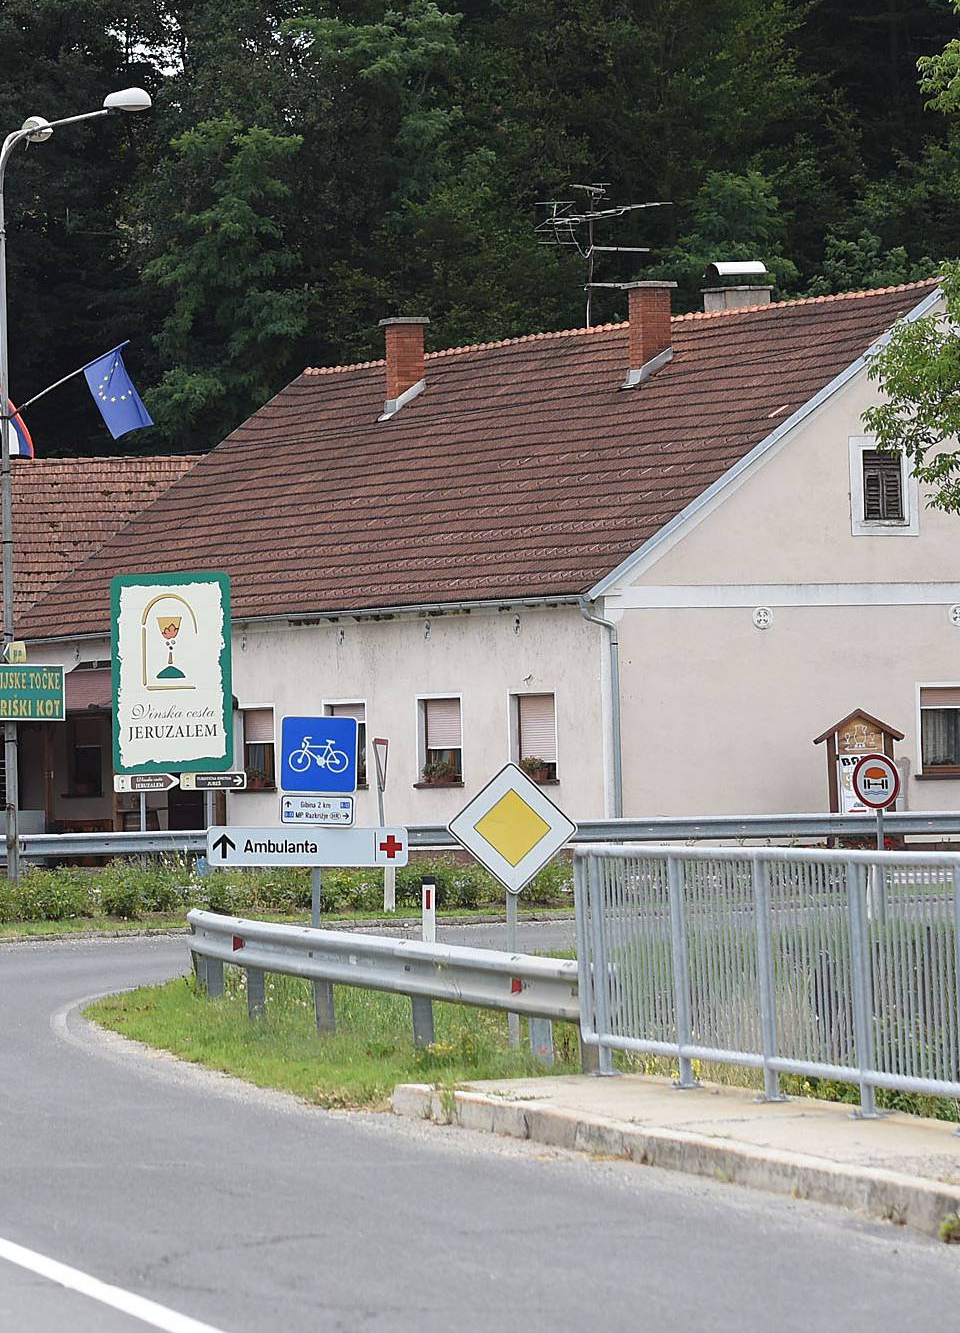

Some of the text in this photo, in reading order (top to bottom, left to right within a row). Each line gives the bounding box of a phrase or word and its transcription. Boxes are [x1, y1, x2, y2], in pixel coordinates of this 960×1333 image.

[29, 668, 61, 689] TOČKE
[36, 699, 61, 716] KOT
[131, 703, 215, 720] Vinska cesta
[129, 724, 217, 742] JERUZALEM
[243, 839, 318, 854] Ambulanta
